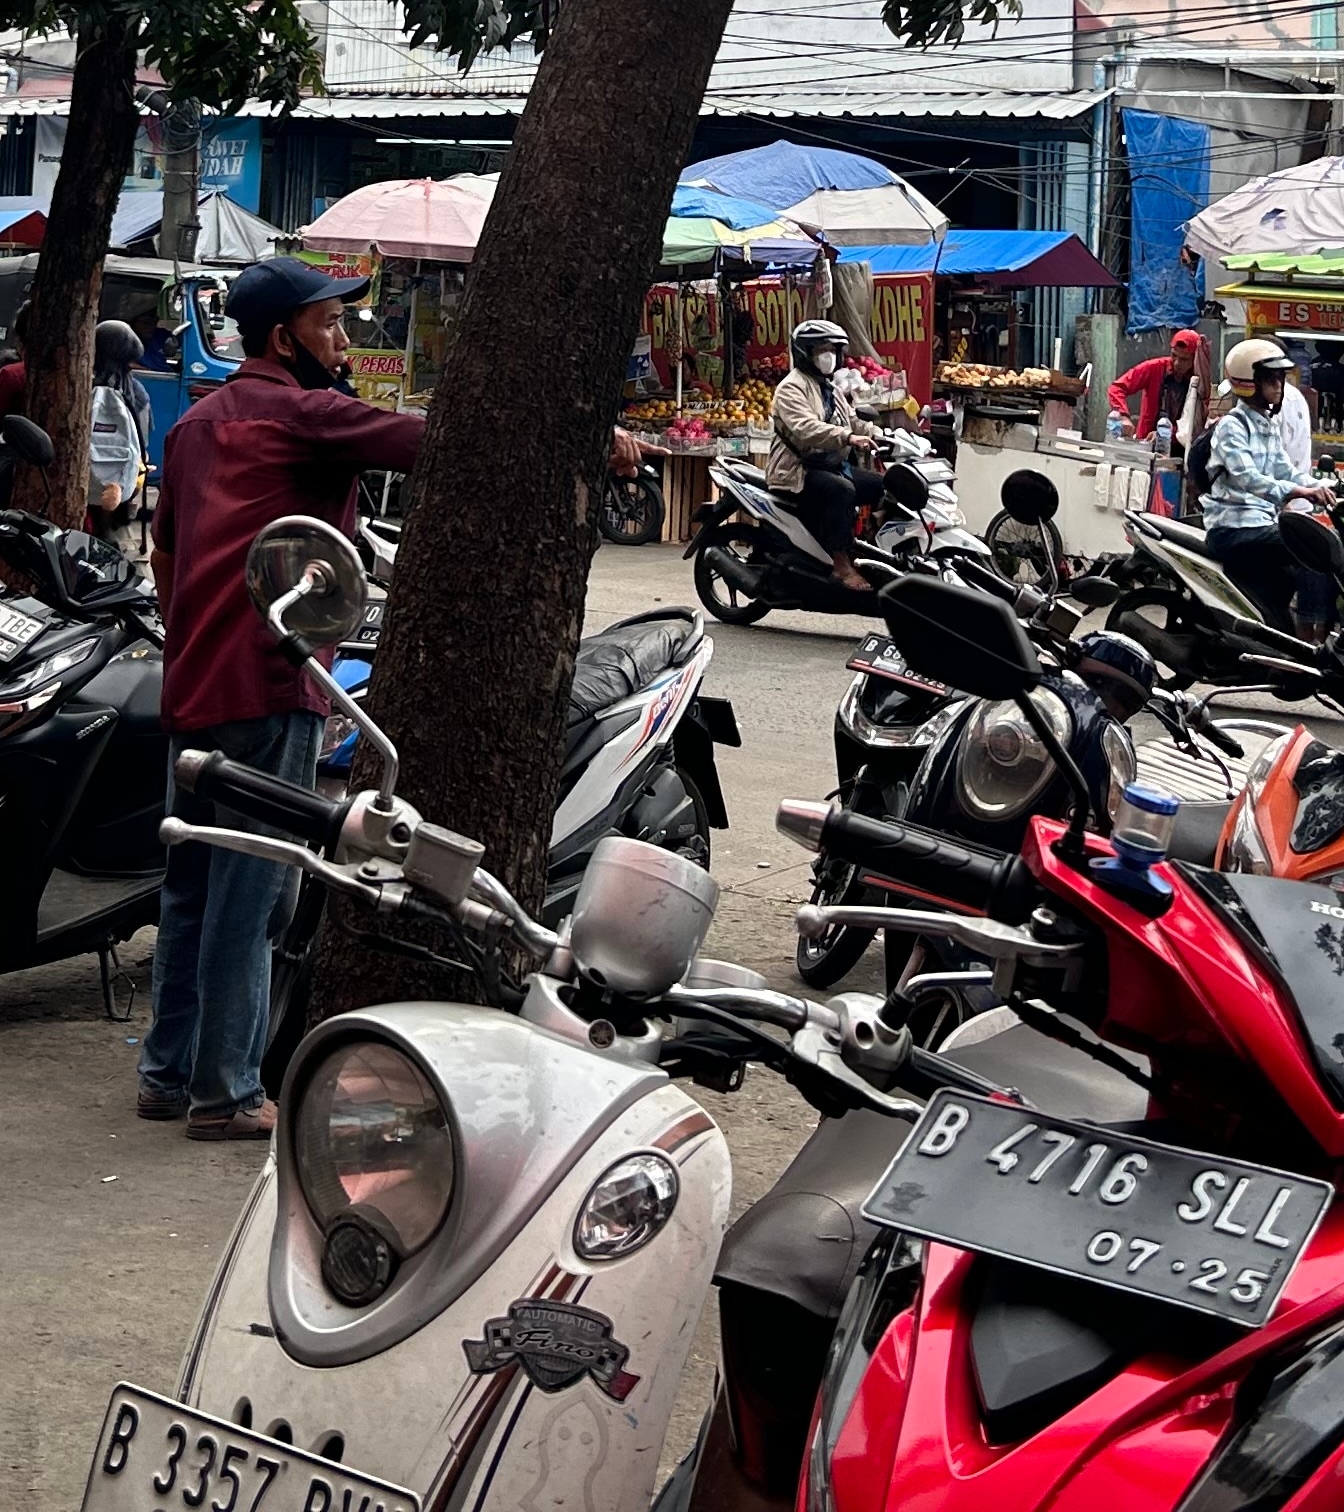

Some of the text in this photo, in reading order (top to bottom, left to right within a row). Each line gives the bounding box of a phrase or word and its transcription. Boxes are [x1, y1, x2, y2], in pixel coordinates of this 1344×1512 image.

[756, 289, 804, 346] SOTO
[1278, 303, 1310, 322] ES
[359, 355, 405, 375] PERAS
[1, 613, 38, 641] TBE
[864, 639, 878, 652] B
[917, 1103, 1293, 1248] B 4716 SLL
[522, 1309, 598, 1333] AUTOMATIC
[515, 1328, 595, 1358] Fino
[102, 1401, 139, 1475] B
[153, 1423, 280, 1512] 3357
